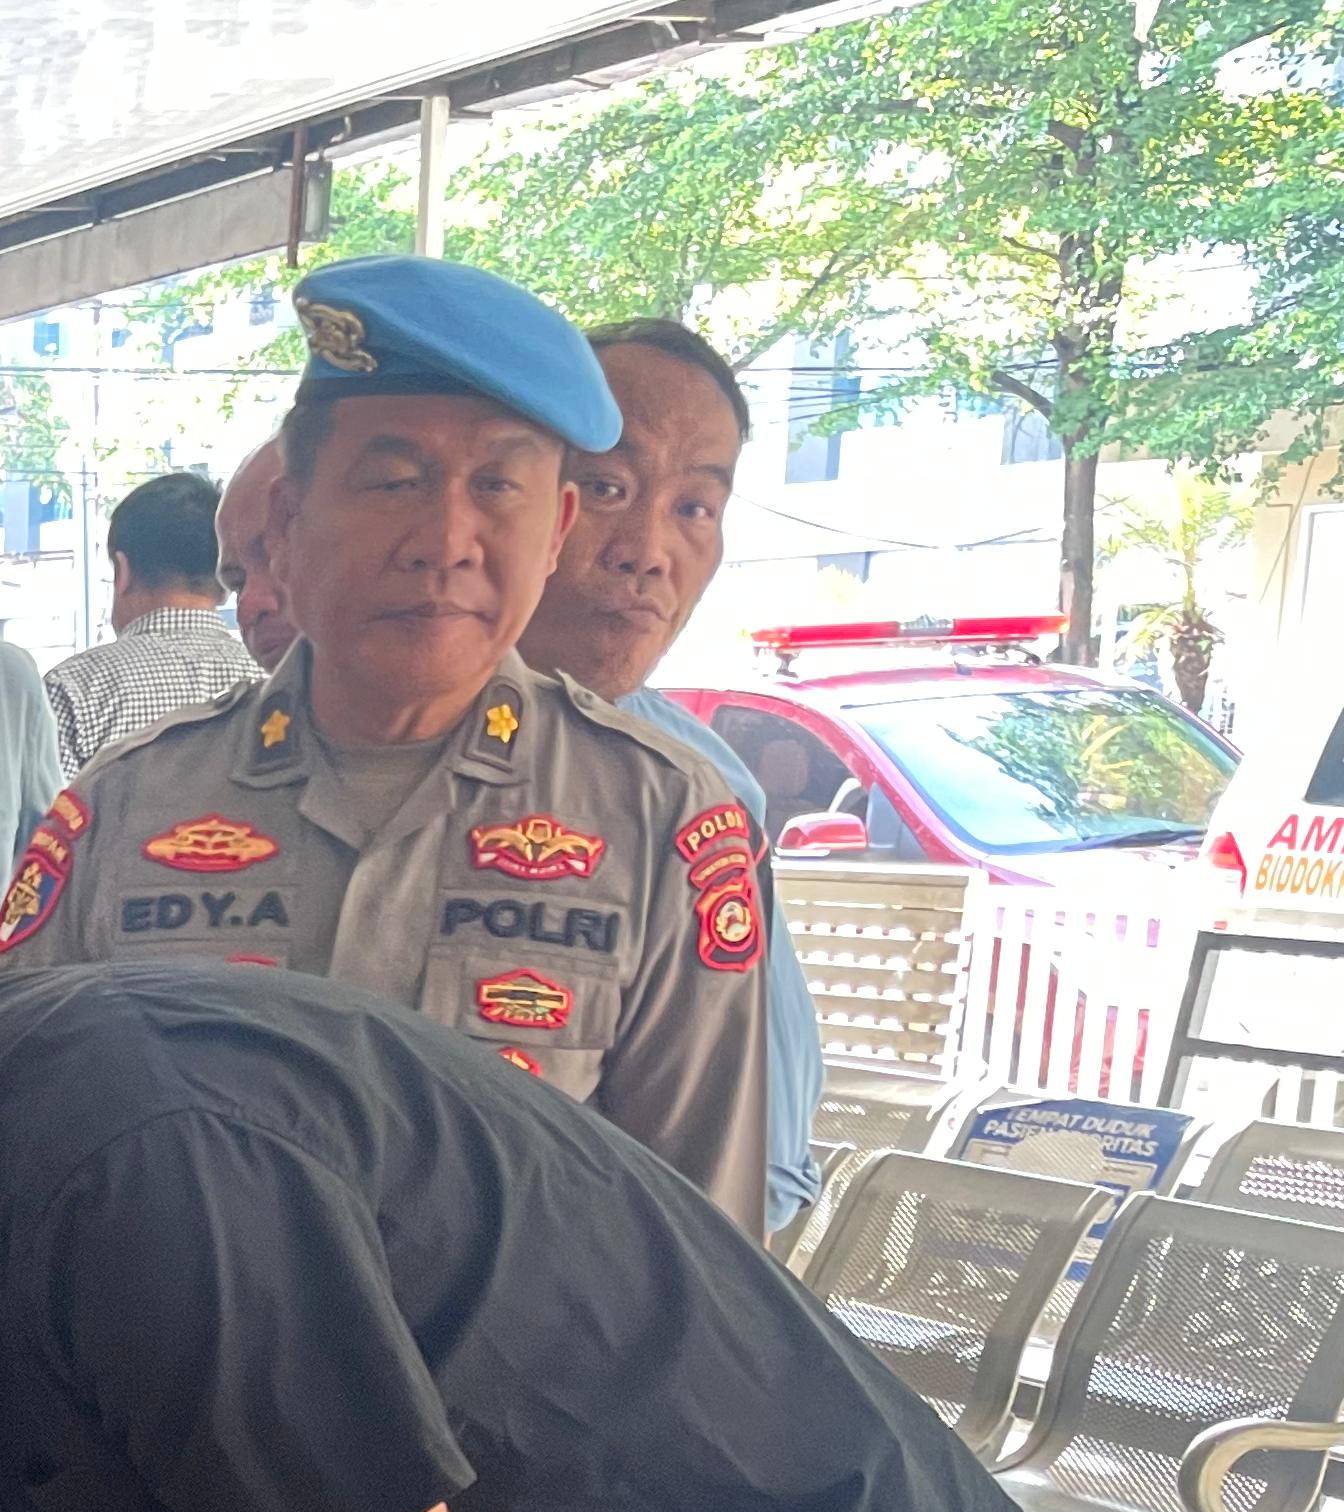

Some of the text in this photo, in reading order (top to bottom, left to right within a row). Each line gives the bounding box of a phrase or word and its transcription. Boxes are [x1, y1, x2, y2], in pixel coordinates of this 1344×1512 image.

[1266, 813, 1344, 854] AM
[1255, 853, 1344, 898] BIDDOK
[121, 890, 290, 933] EDY.A
[440, 897, 620, 952] POLRI
[1006, 1107, 1158, 1139] TEMPAT DUDUK
